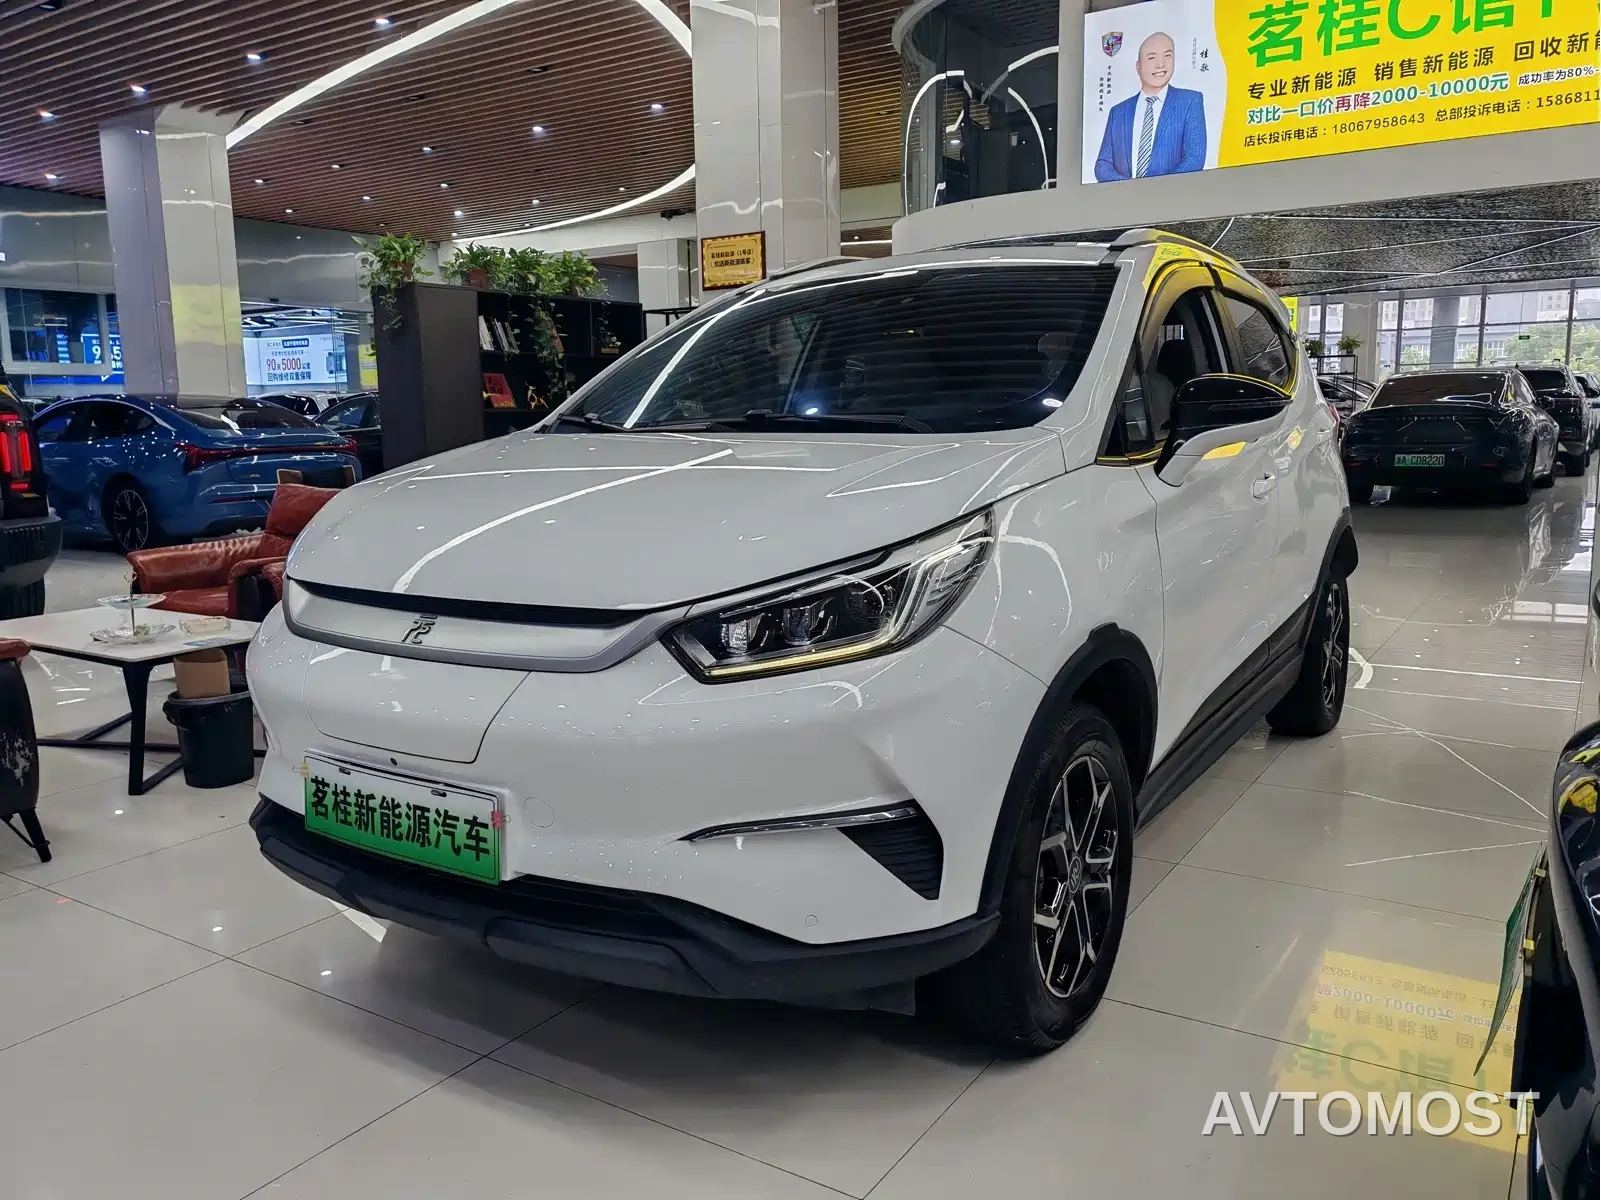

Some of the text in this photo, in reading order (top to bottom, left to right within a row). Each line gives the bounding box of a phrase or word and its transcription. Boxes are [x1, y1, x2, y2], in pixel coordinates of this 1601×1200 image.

[1247, 67, 1357, 100] 专业新能源
[1374, 46, 1495, 82] 销售新能源
[1247, 73, 1509, 125] 对比一口价再降2000-10000元
[310, 775, 491, 862] 茗桂新能源汽车
